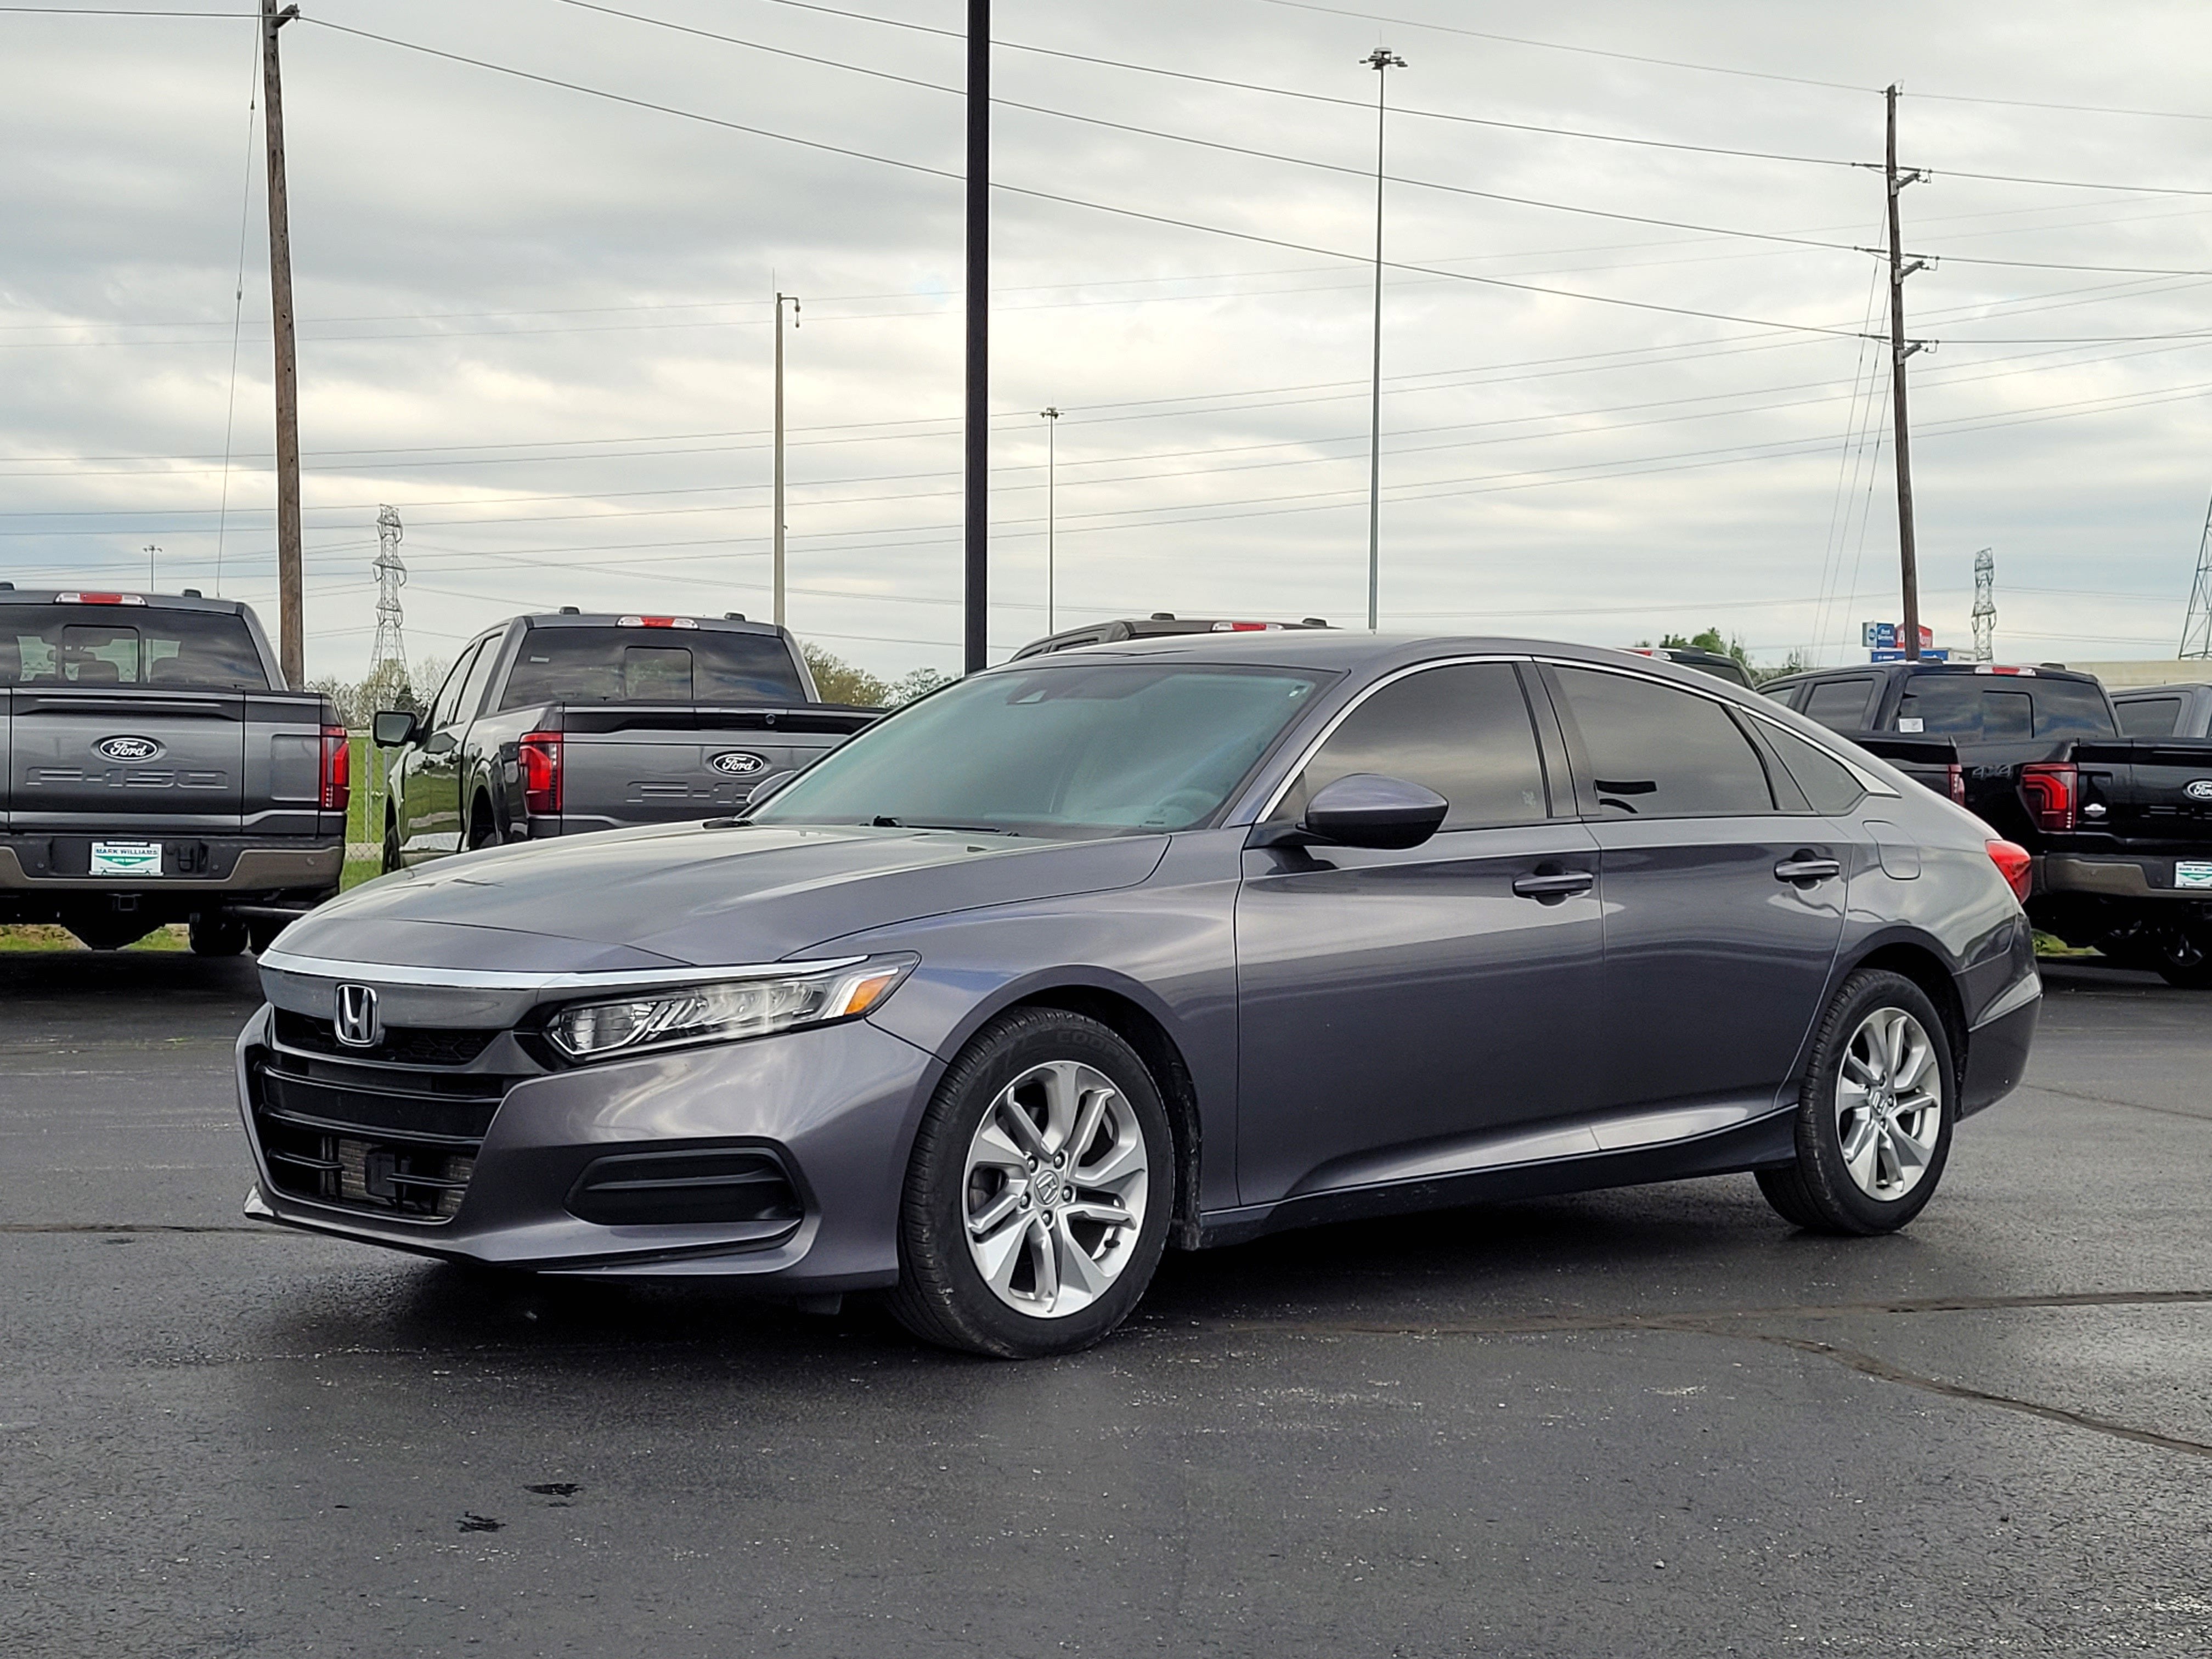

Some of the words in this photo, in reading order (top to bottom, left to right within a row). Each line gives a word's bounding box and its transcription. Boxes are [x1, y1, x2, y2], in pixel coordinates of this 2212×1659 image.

[109, 741, 147, 757] Ford
[722, 757, 755, 771] Ford
[25, 766, 229, 789] F-150
[627, 781, 760, 804] F-1
